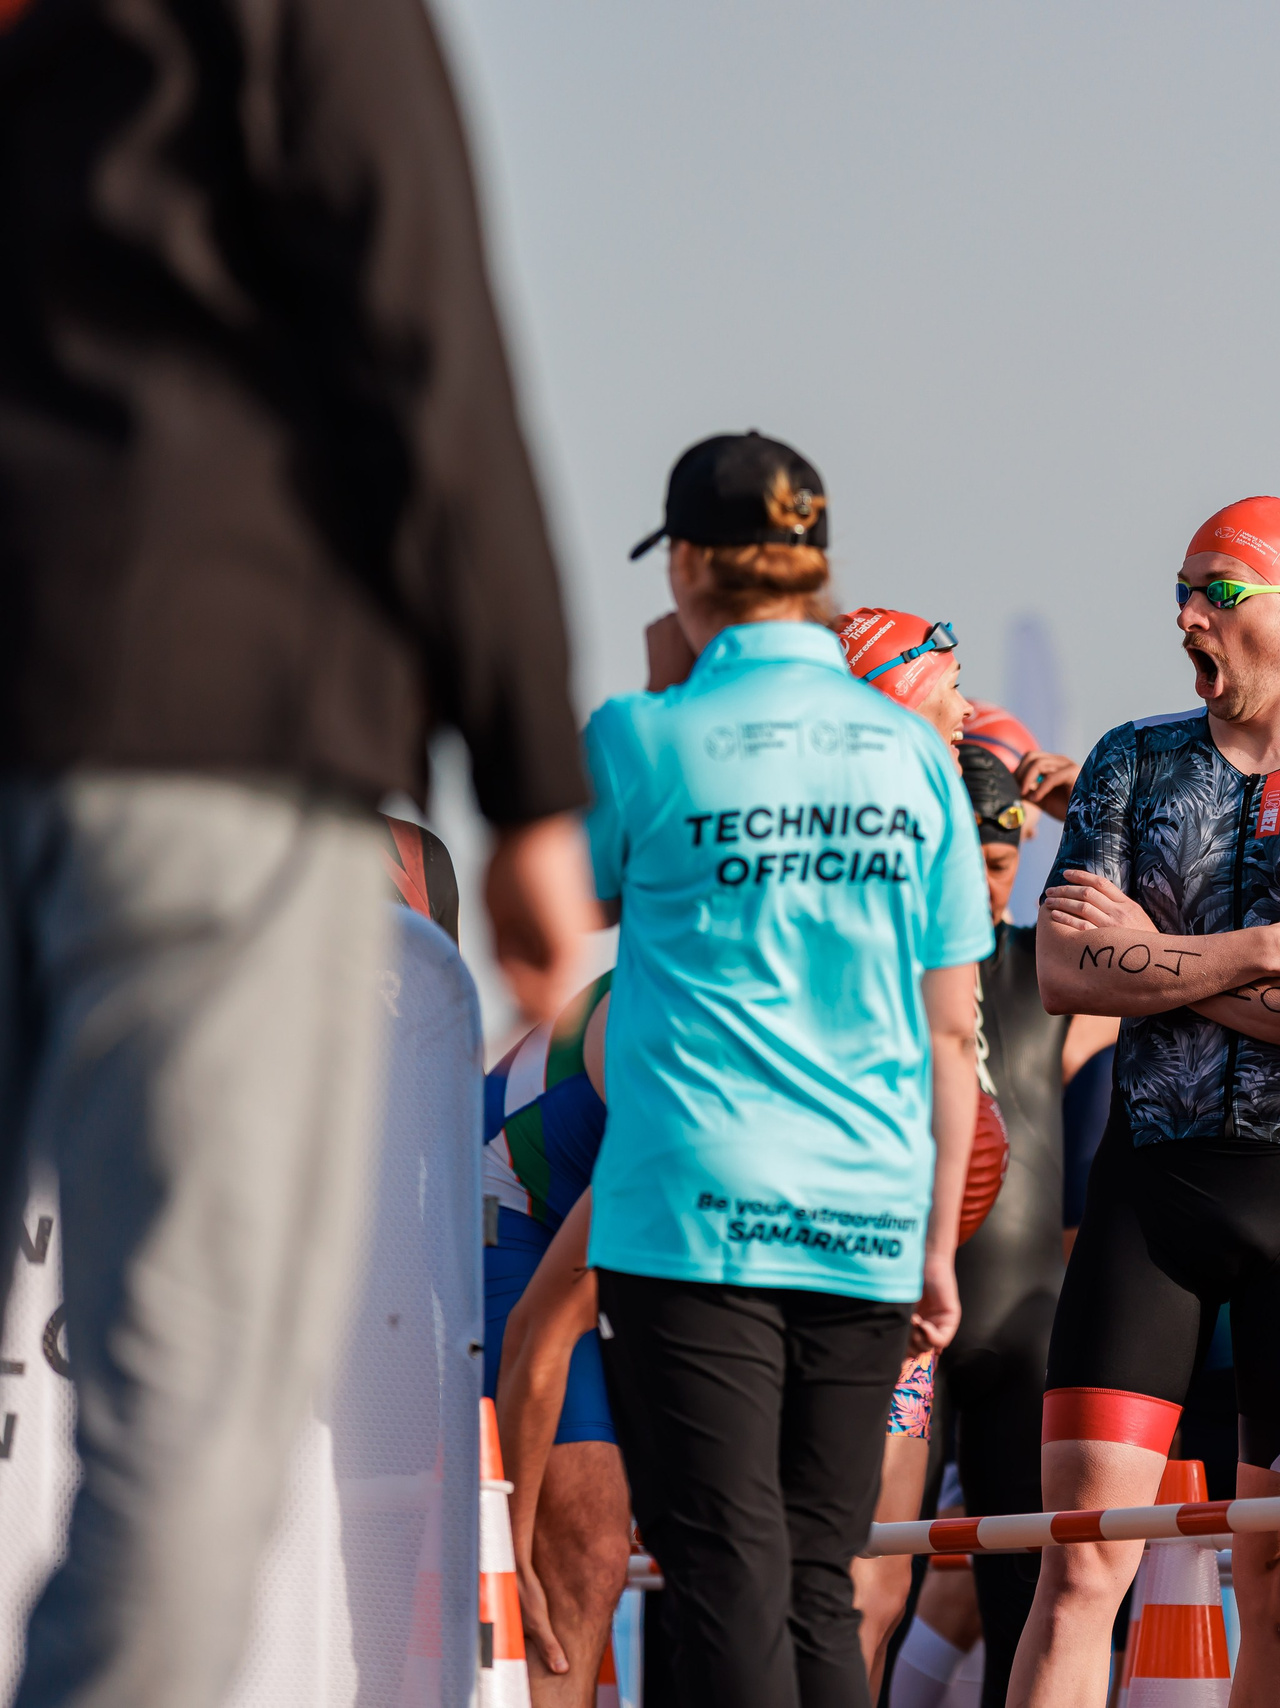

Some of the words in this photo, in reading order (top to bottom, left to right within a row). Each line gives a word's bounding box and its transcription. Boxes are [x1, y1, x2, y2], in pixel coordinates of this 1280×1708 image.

[1251, 539, 1262, 548] Cup
[848, 614, 883, 641] Triathlon
[849, 651, 864, 667] your
[862, 619, 896, 652] extraordinary
[685, 805, 926, 847] TECHNICAL
[717, 851, 909, 886] OFFICIAL
[697, 1192, 728, 1211] Be
[735, 1198, 790, 1214] your
[728, 1220, 903, 1257] SAMARKAND
